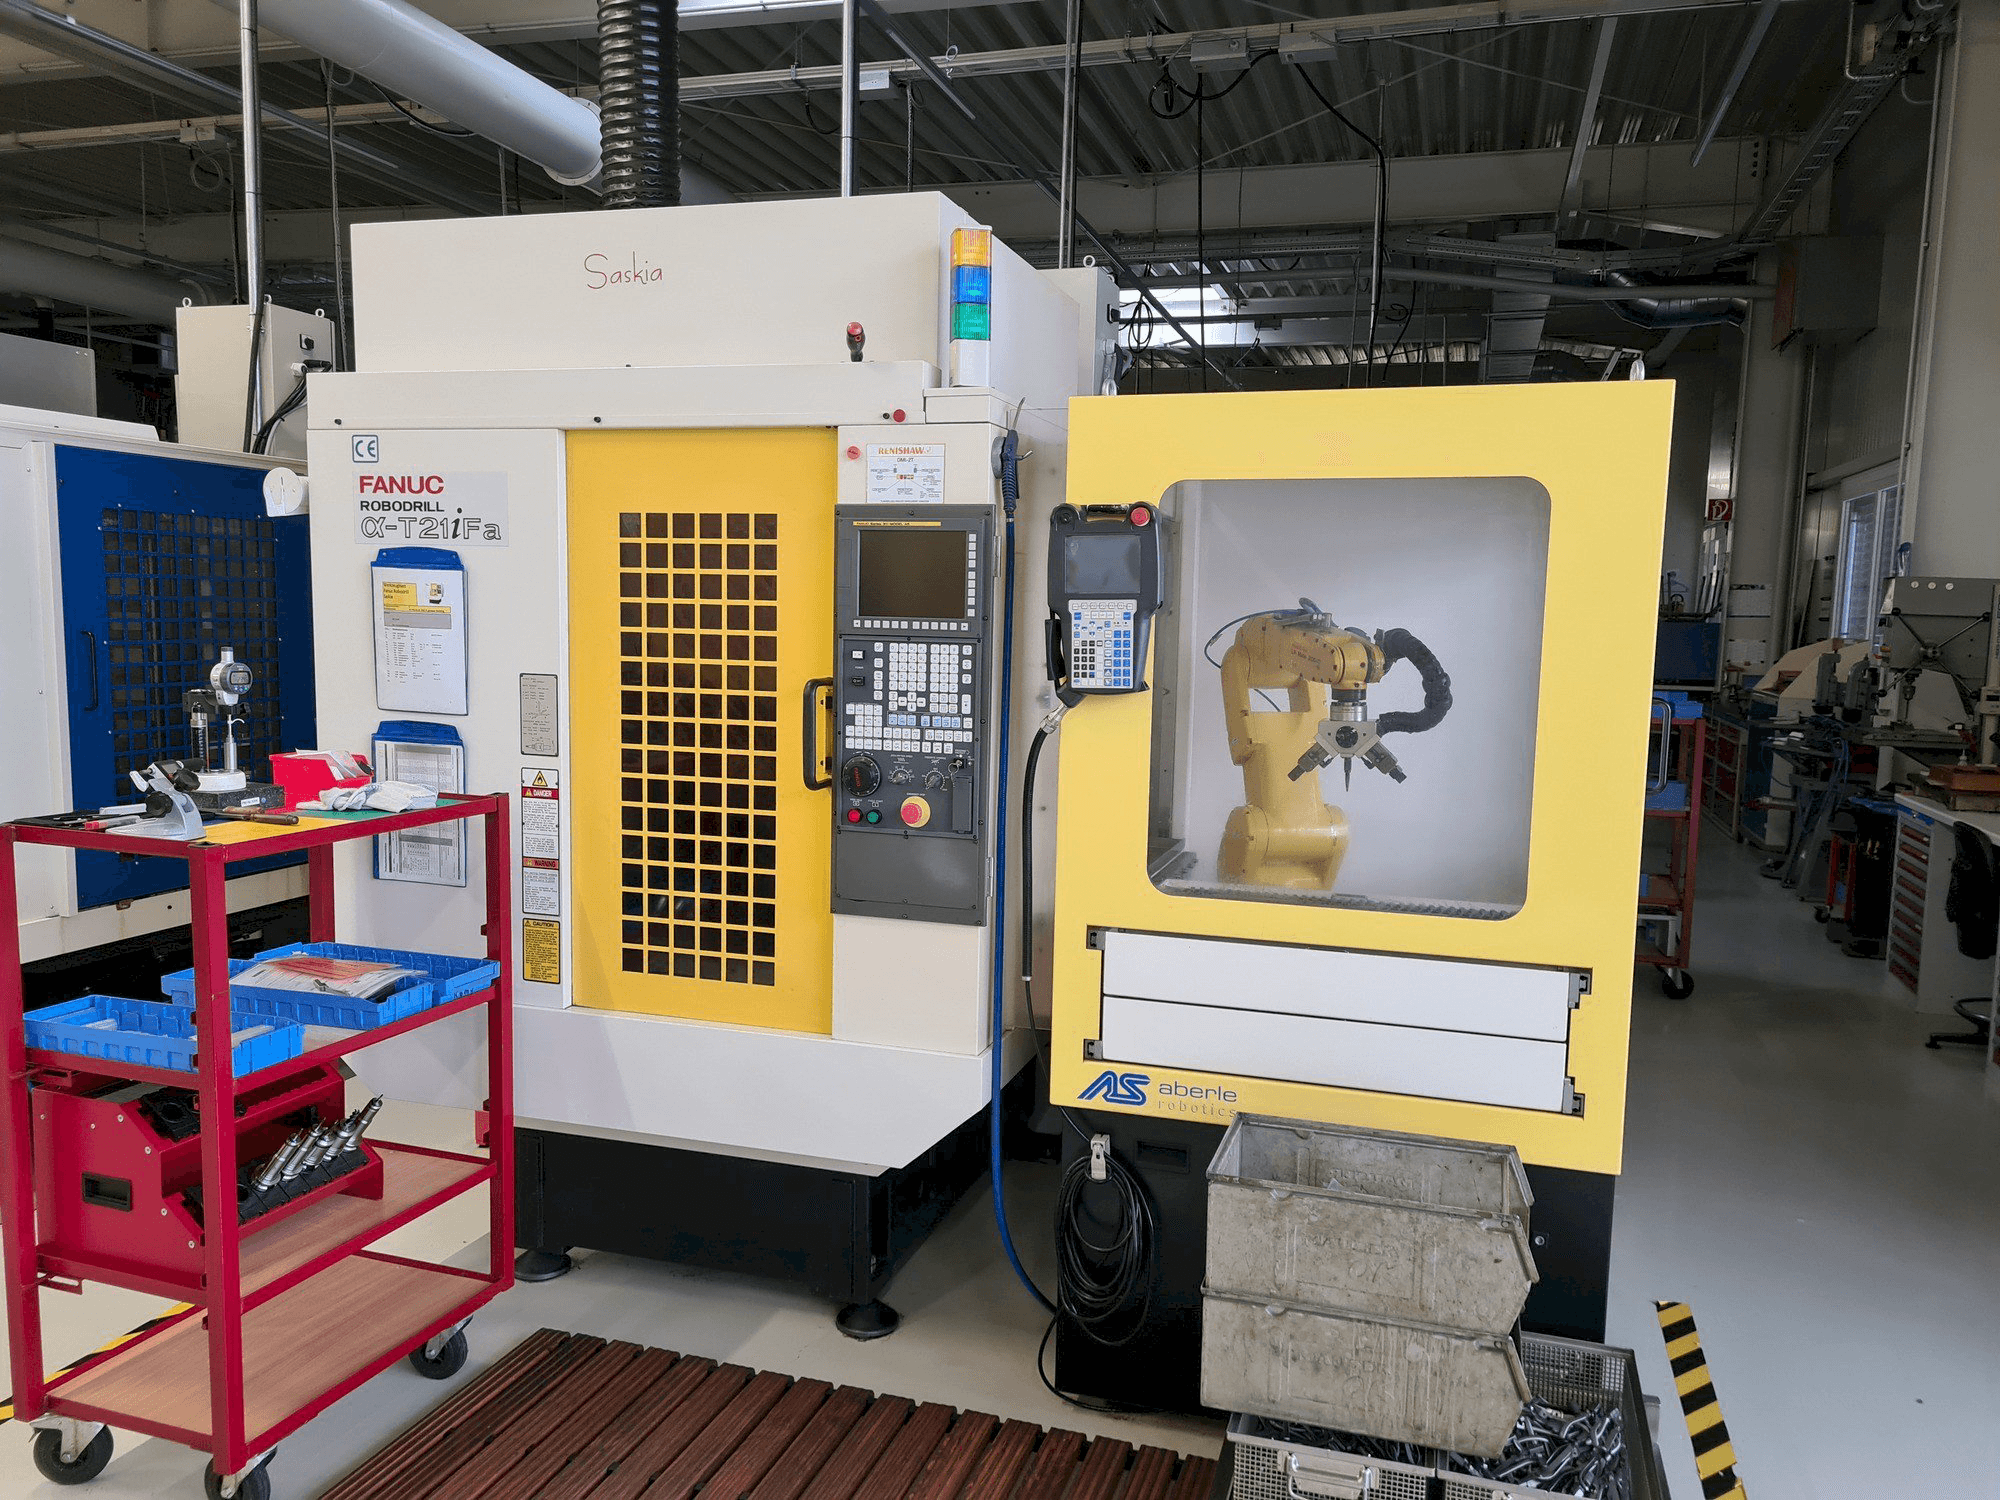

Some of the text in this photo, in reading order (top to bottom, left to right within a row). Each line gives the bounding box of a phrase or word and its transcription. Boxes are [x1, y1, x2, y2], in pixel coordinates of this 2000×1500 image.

[584, 251, 663, 290] Saskia
[355, 440, 376, 458] CE
[878, 446, 925, 455] RENISHAW
[359, 475, 445, 495] FANUC
[360, 501, 445, 513] ROBODRILL
[533, 789, 552, 797] DANGER
[534, 860, 556, 868] WARNING
[1159, 1081, 1237, 1103] aberle
[1158, 1100, 1237, 1118] robotics
